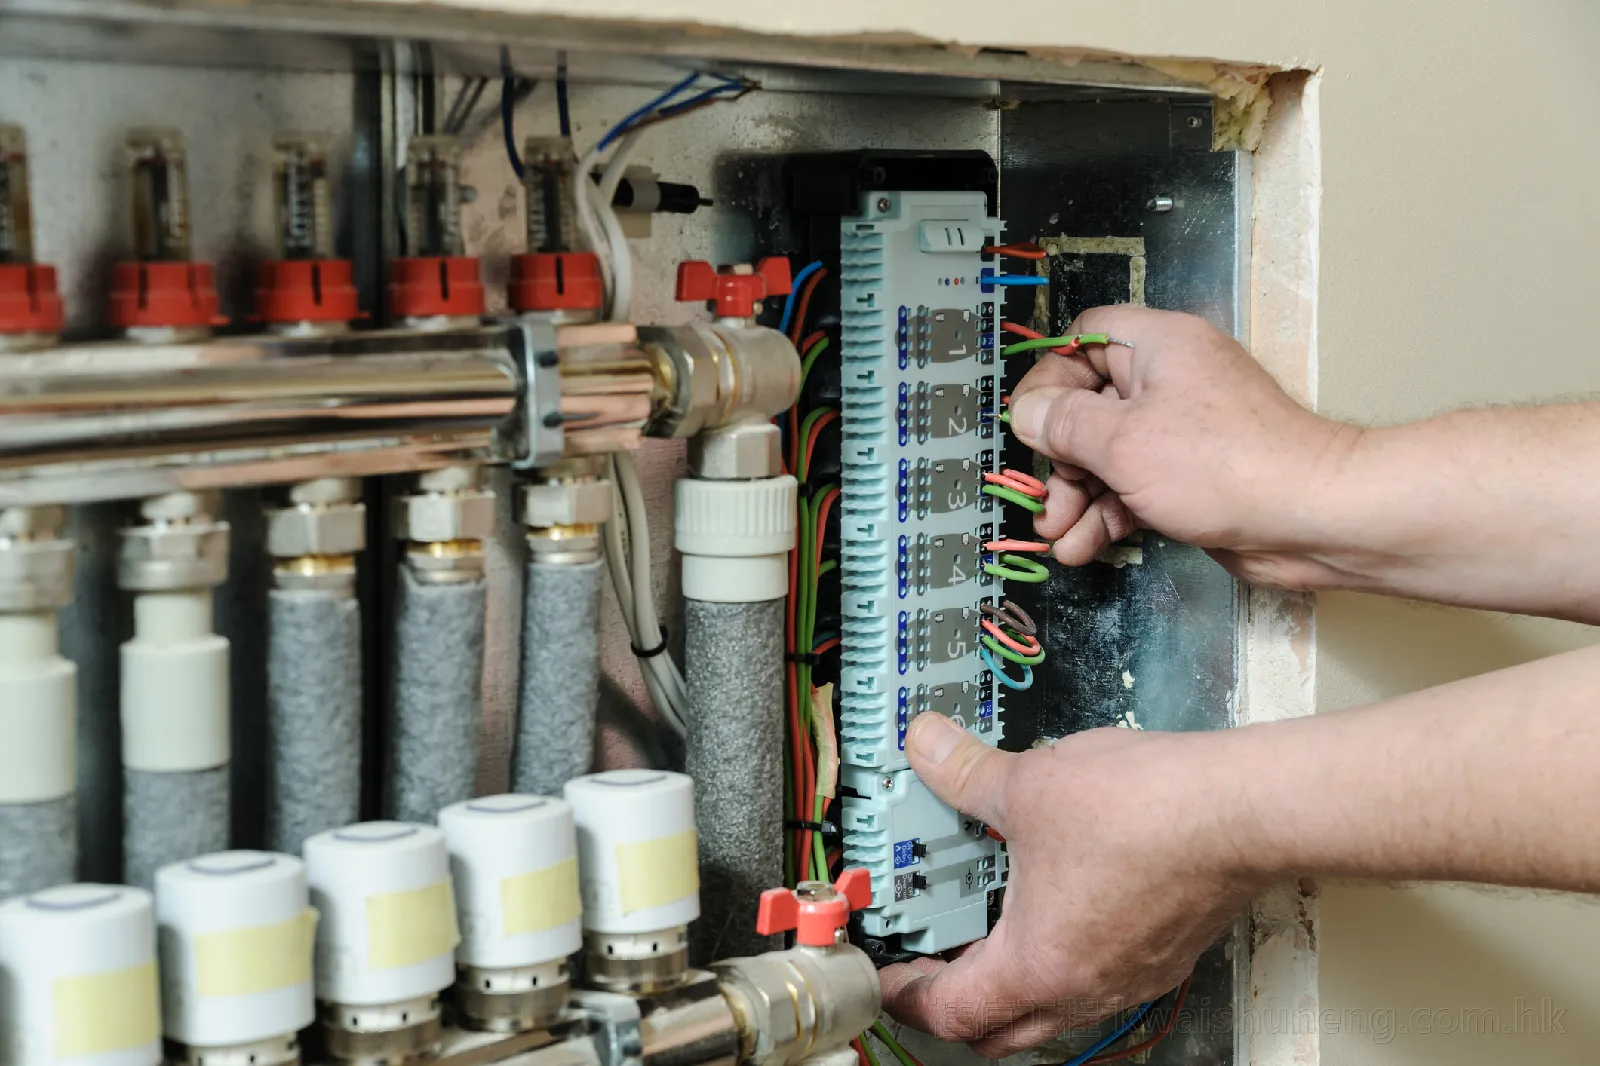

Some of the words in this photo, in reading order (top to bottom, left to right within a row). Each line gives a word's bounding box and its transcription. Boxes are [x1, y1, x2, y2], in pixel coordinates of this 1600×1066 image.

[948, 344, 967, 356] 1
[948, 417, 967, 436] 2
[947, 492, 967, 510] 3
[947, 565, 966, 584] 4
[947, 641, 967, 658] 5
